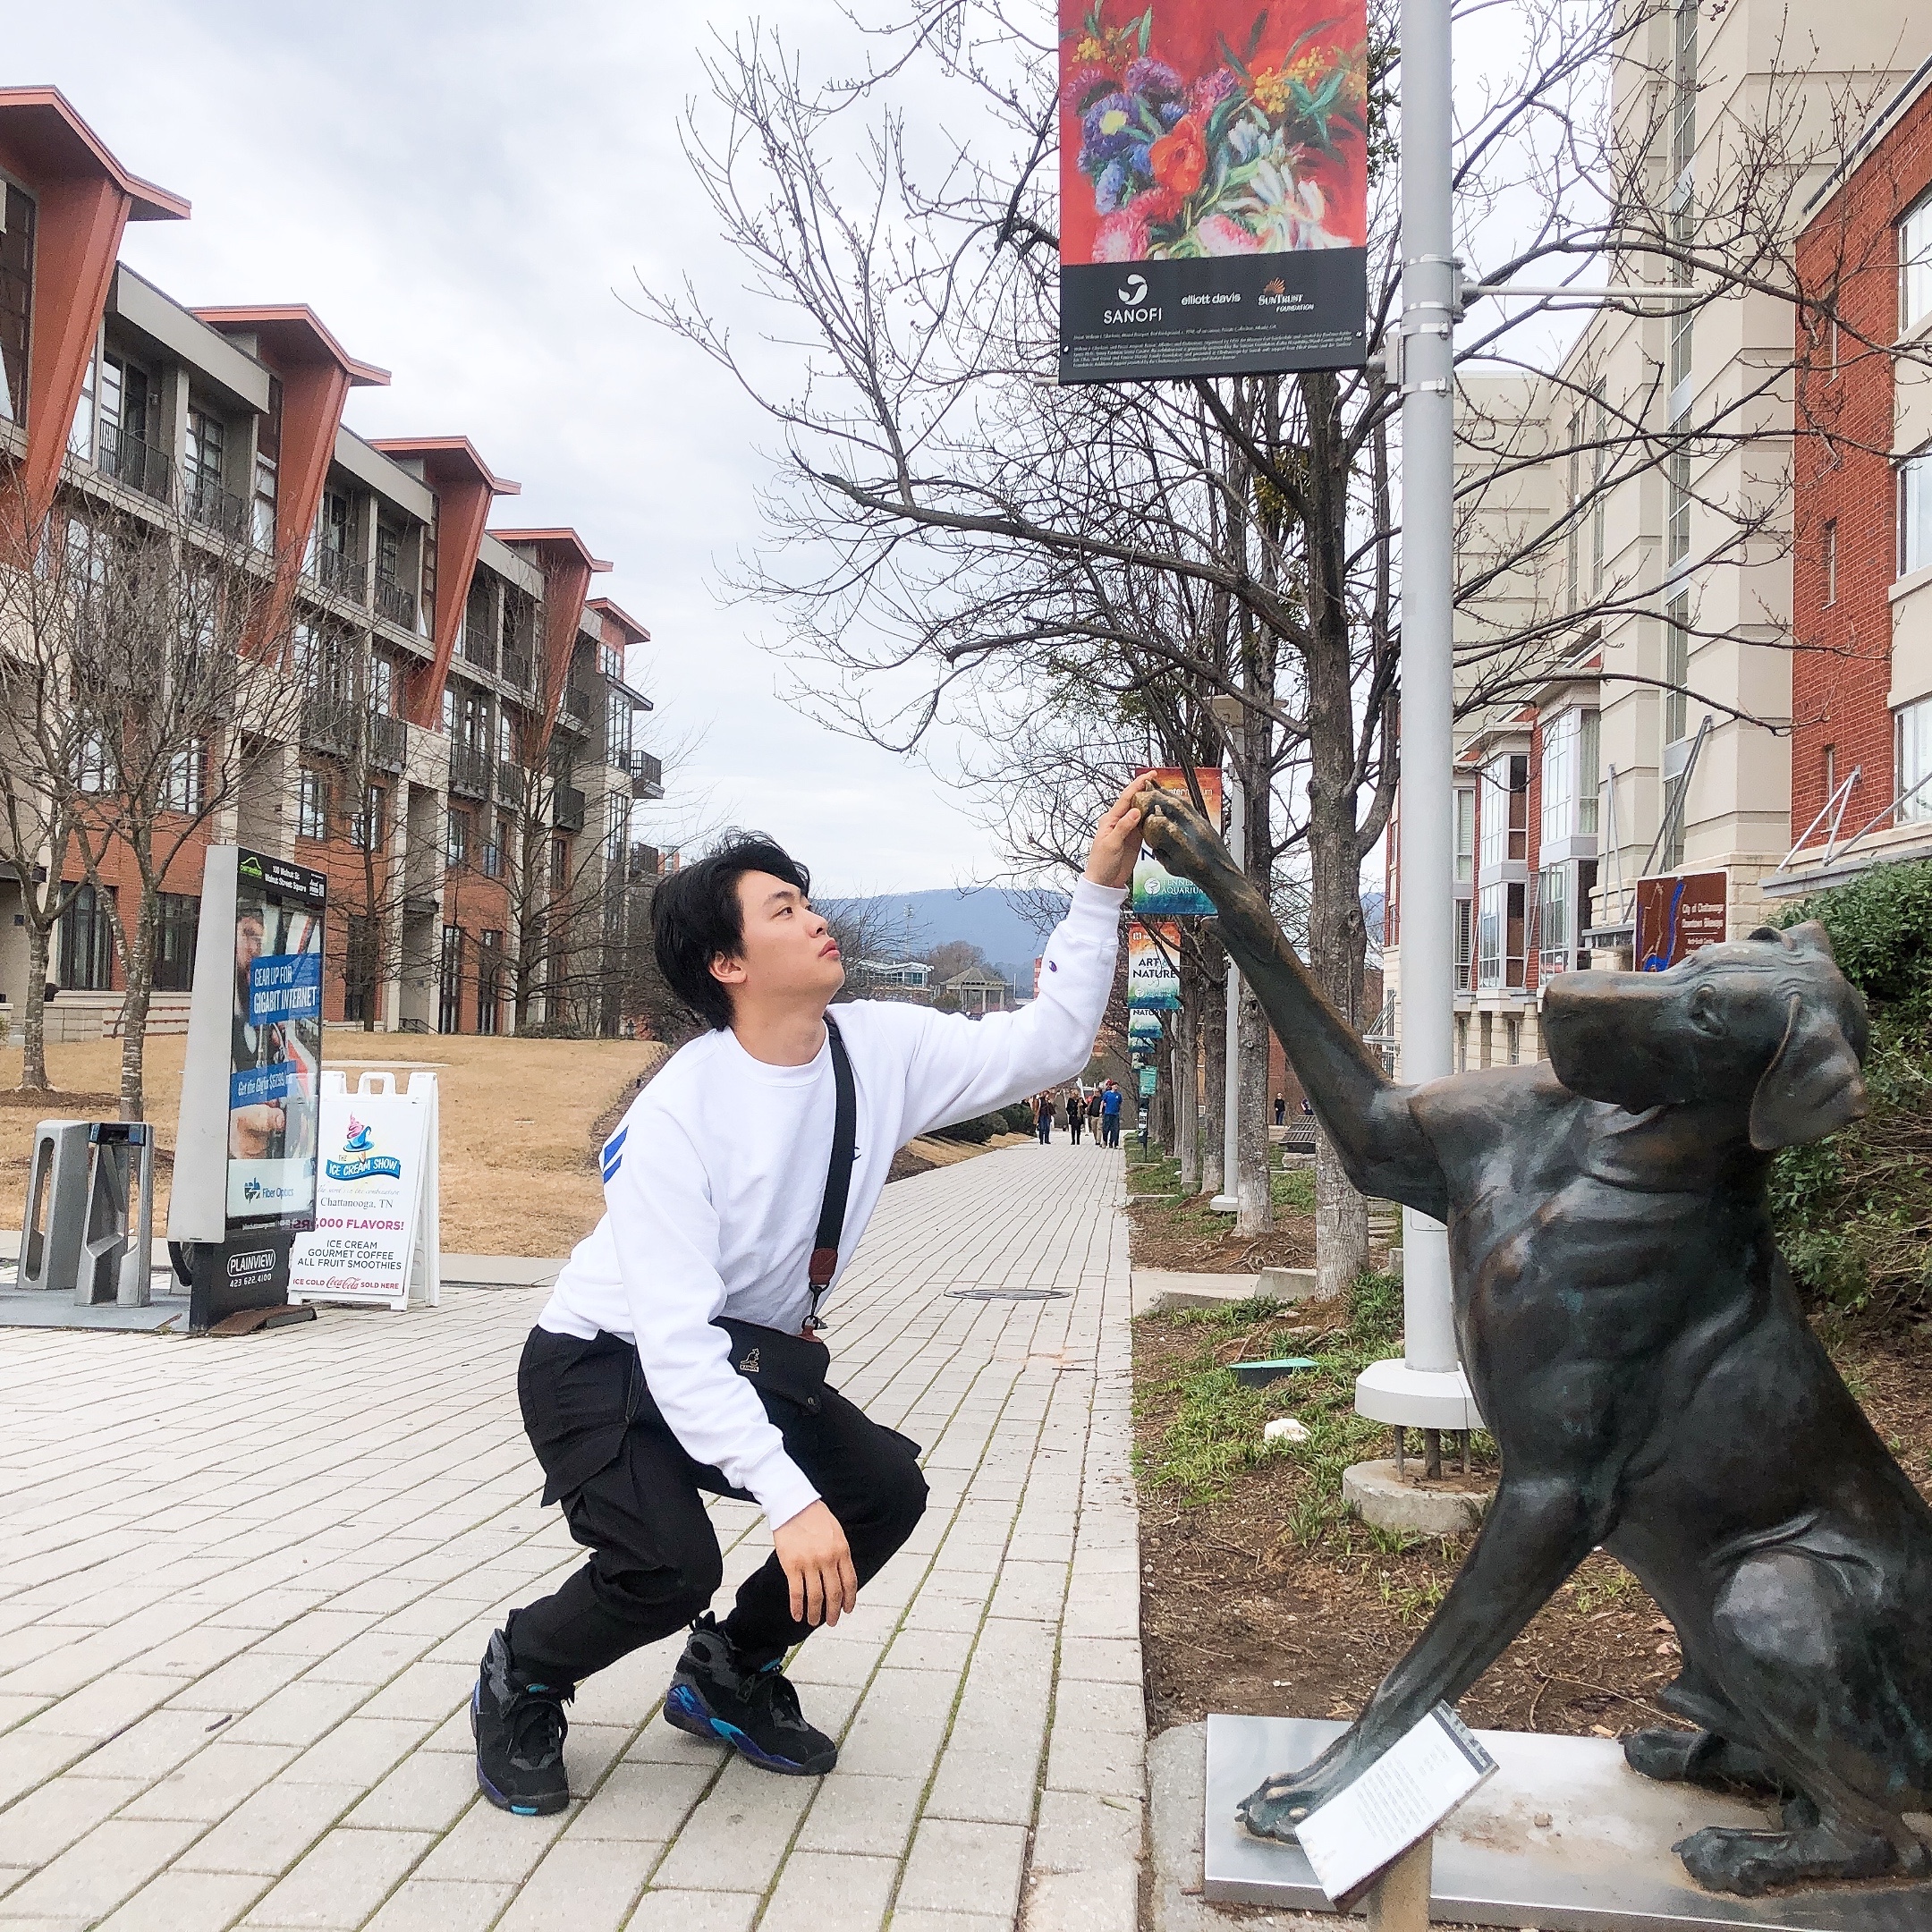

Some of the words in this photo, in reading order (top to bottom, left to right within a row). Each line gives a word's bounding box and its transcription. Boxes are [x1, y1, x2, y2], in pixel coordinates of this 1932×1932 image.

[1181, 293, 1210, 305] elliott
[1212, 292, 1241, 304] davis
[1276, 303, 1315, 312] FOUNDATION
[1103, 307, 1162, 325] SANOFI
[1139, 958, 1160, 967] ART
[254, 968, 270, 987] GEAR
[270, 967, 279, 985] UP
[280, 965, 292, 984] FOR
[254, 990, 281, 1013] GIGABIT
[281, 986, 318, 1010] INTERNET
[329, 1163, 342, 1175] ICE
[343, 1159, 371, 1176] CREAM
[373, 1157, 398, 1170] SHOW
[262, 1188, 275, 1199] Fiber
[275, 1187, 294, 1199] Optics
[379, 1199, 394, 1208] TN
[345, 1219, 404, 1230] FLAVORS!
[326, 1240, 342, 1248] ICE
[344, 1241, 377, 1249] CREAM
[308, 1249, 354, 1258] GOURMET
[357, 1251, 394, 1260] COFFEE
[230, 1253, 274, 1273] PLAINVIEW
[298, 1258, 315, 1267] ALL
[318, 1259, 345, 1267] FRUIT
[347, 1260, 402, 1270] SMOOTHIES
[229, 1278, 242, 1288] 423
[243, 1274, 272, 1285] 622.4100
